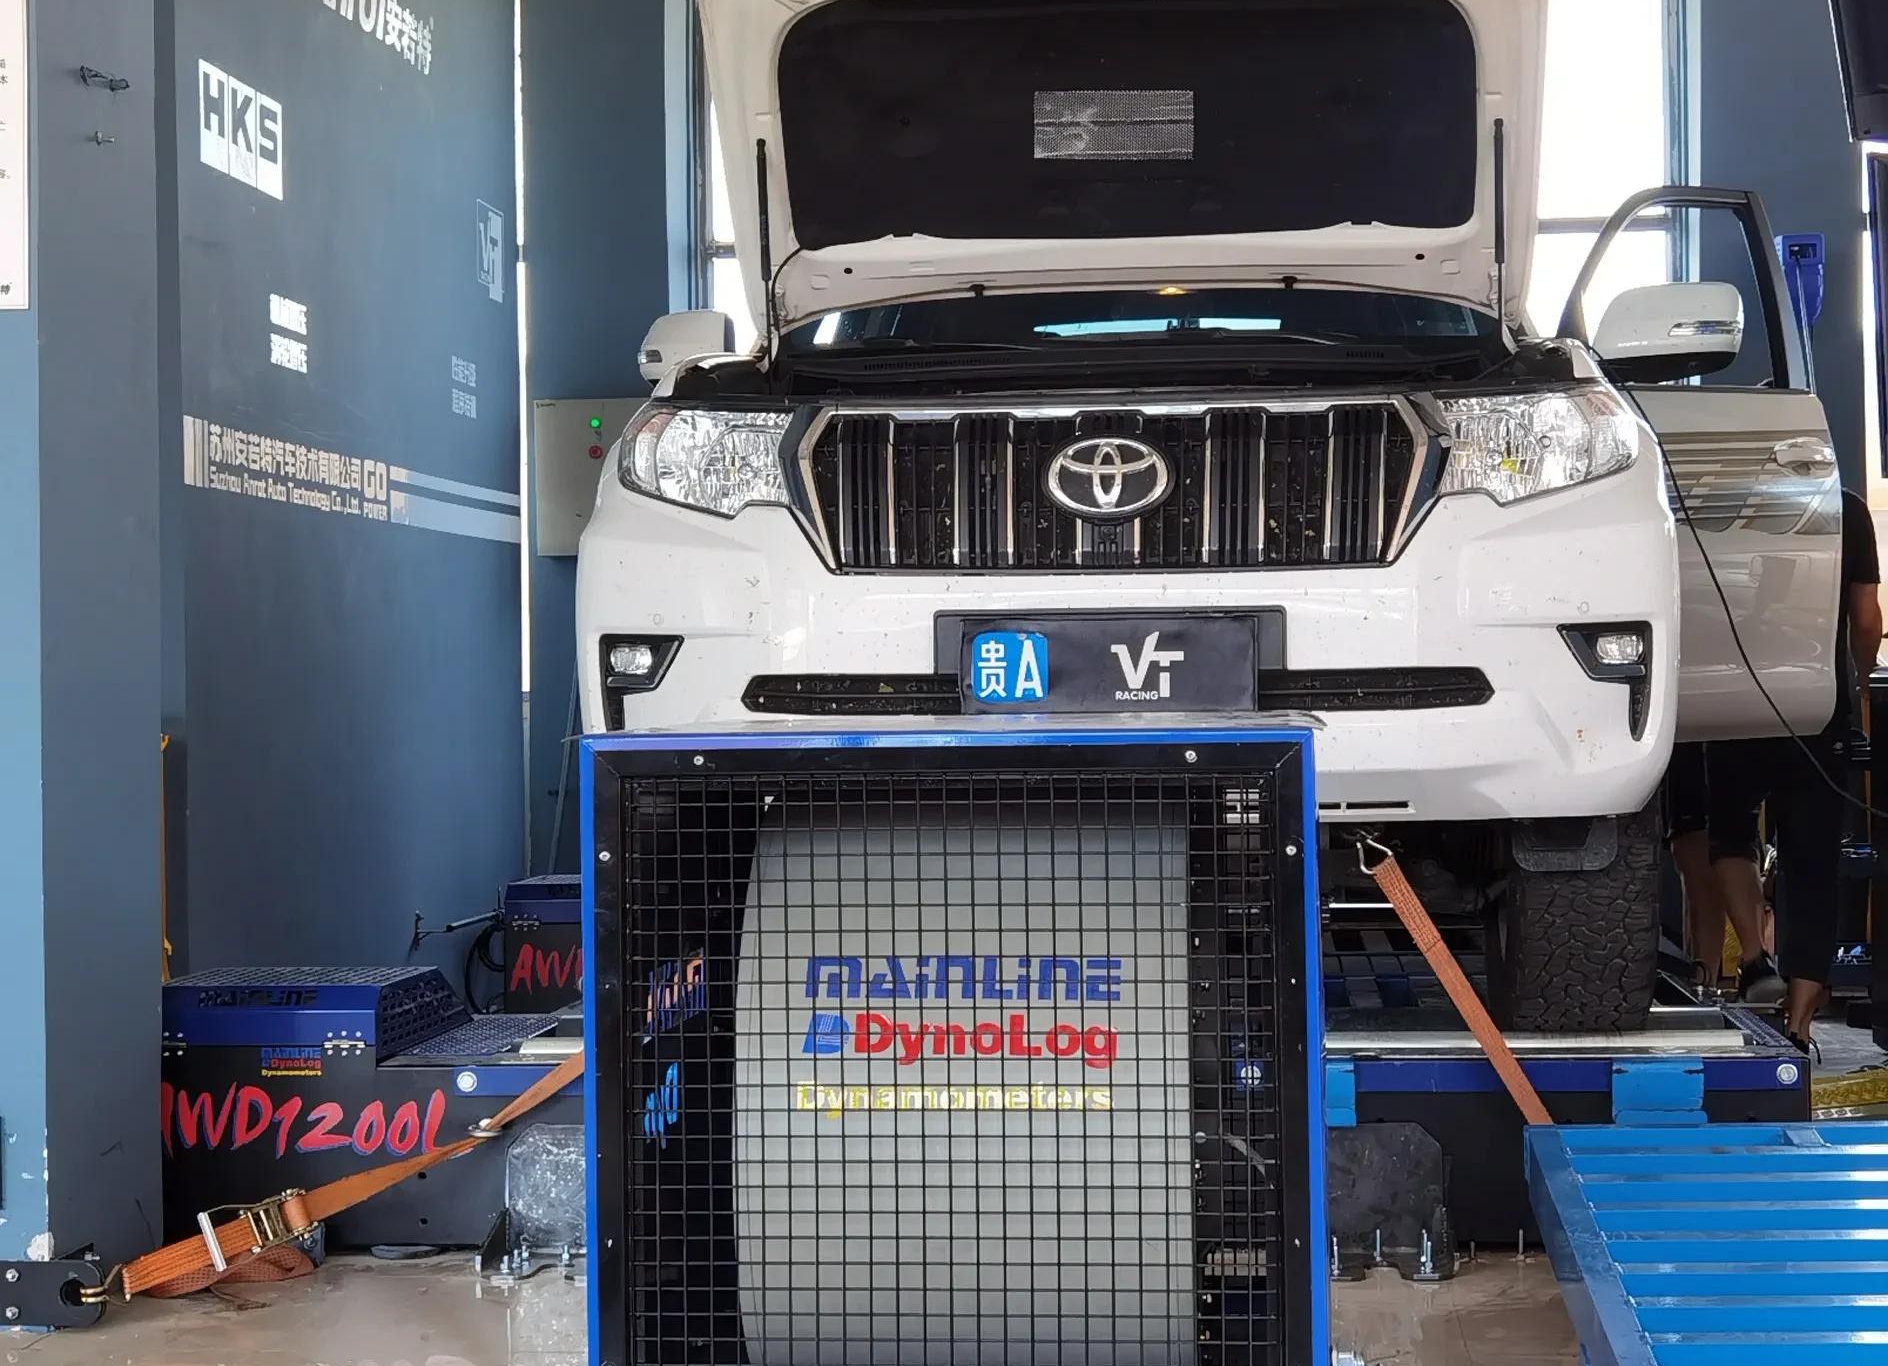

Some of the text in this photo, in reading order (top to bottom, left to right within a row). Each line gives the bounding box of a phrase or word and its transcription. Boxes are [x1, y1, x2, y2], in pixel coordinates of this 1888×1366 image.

[203, 70, 279, 166] HKS
[209, 424, 361, 491] 苏州安若特汽车技术有限公司
[364, 459, 387, 501] GO
[209, 466, 241, 493] Suzhou
[242, 473, 266, 498] Anrot
[267, 478, 287, 502] Auto
[287, 482, 331, 512] Technology
[363, 502, 388, 521] POWER
[1110, 631, 1184, 698] VT
[1115, 690, 1159, 700] RACING
[510, 943, 583, 996] AW
[271, 1058, 321, 1068] DynoLog
[854, 1012, 1118, 1069] DynoLog
[796, 1081, 1114, 1120] Dynamometers
